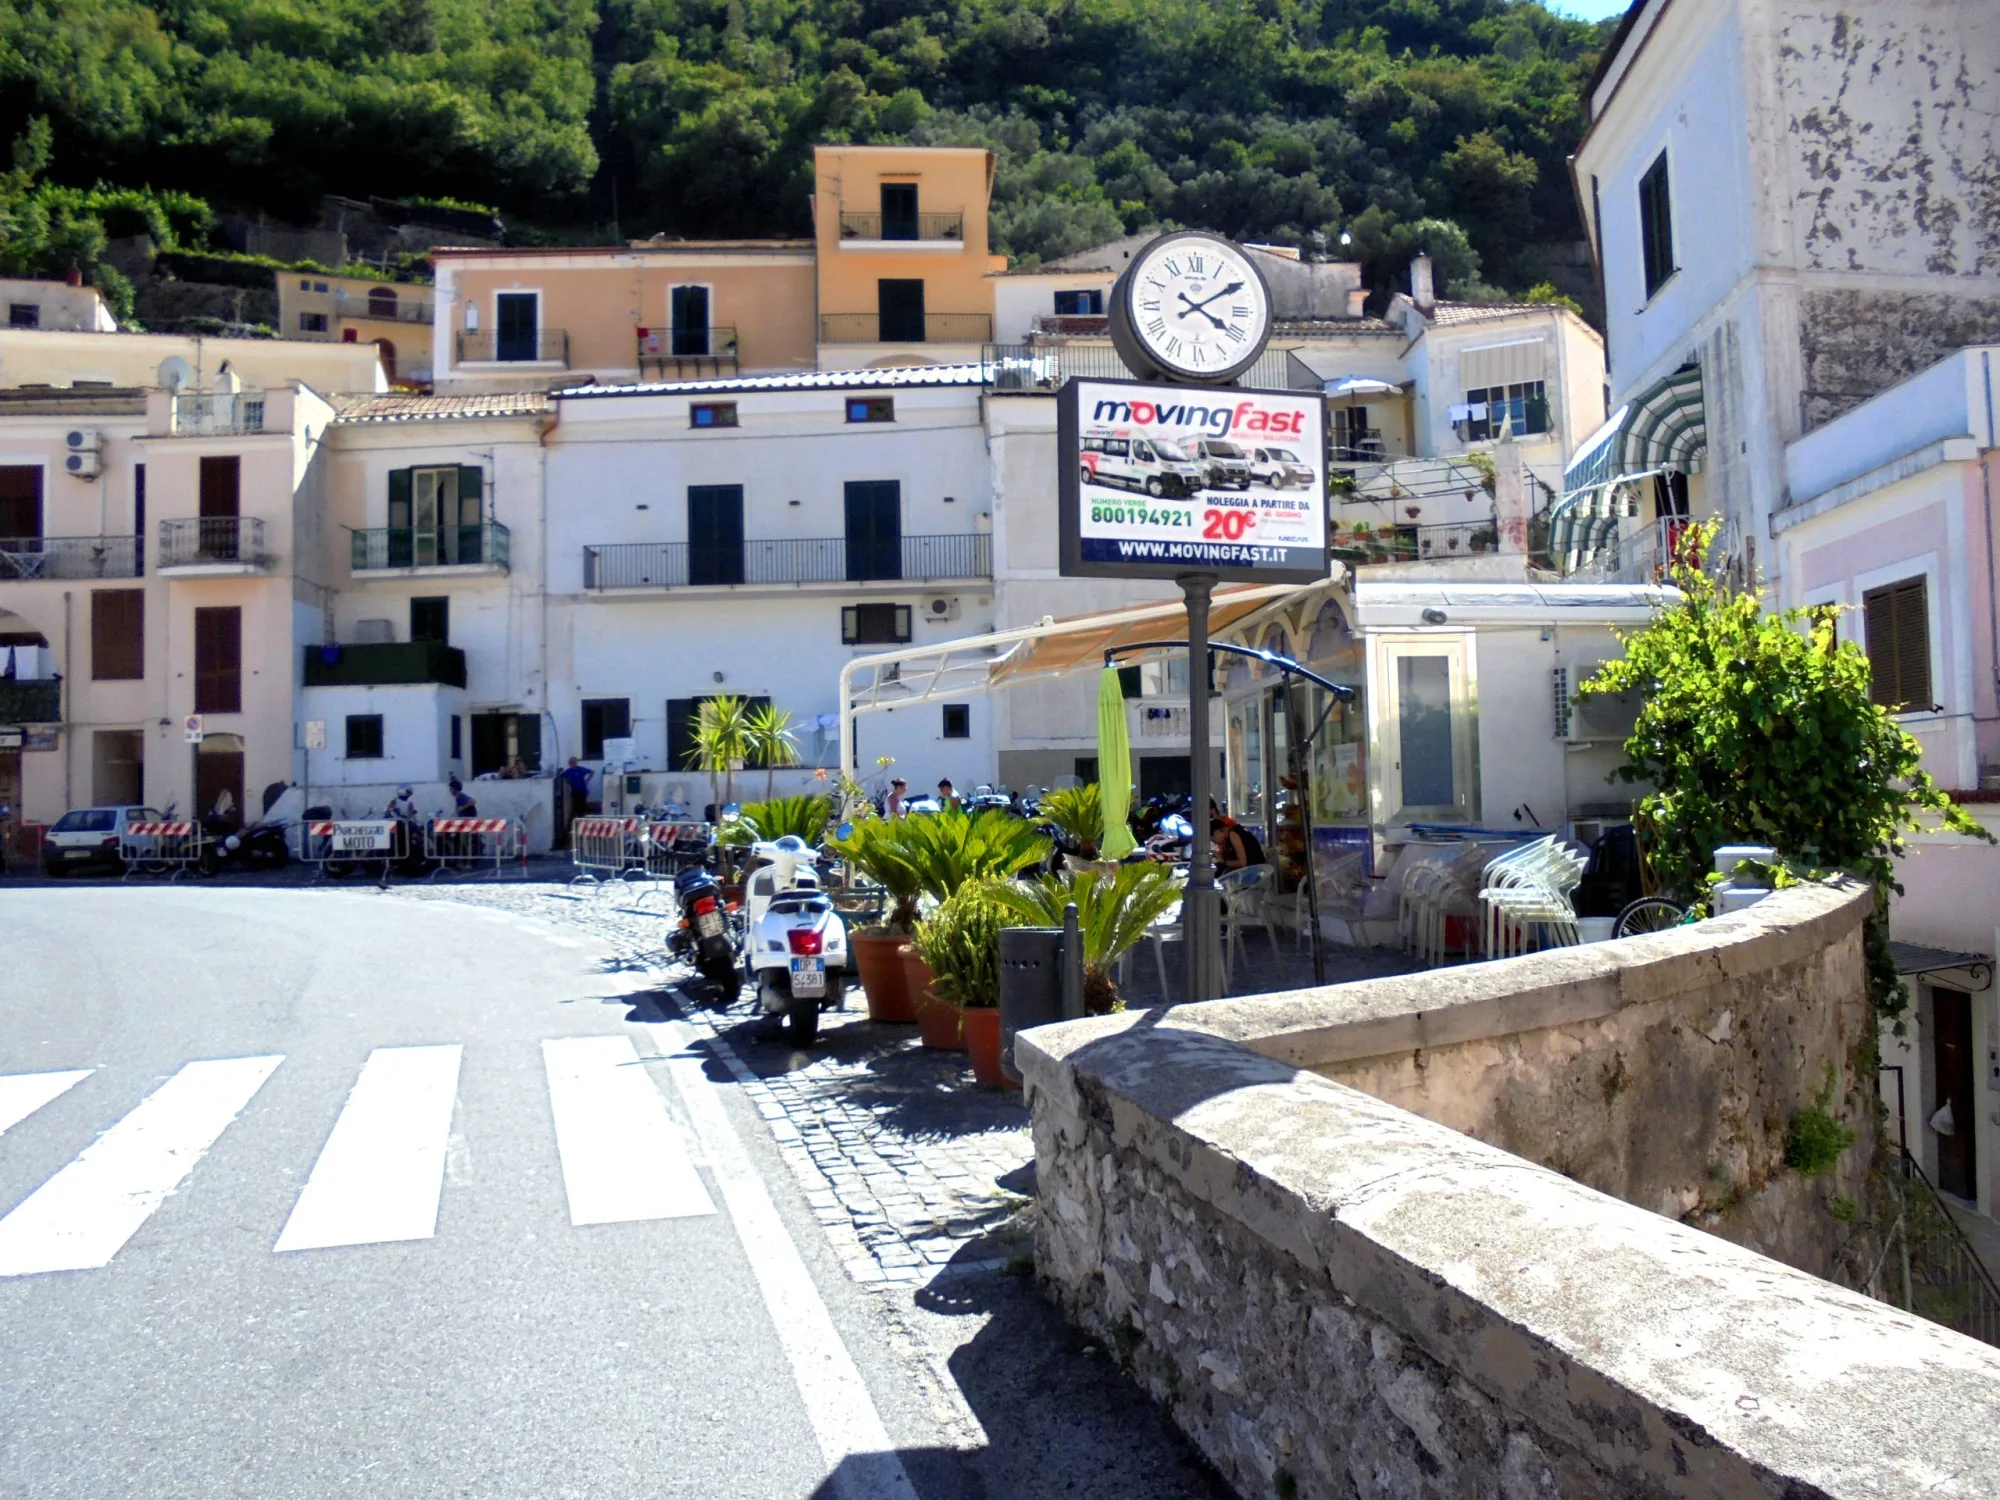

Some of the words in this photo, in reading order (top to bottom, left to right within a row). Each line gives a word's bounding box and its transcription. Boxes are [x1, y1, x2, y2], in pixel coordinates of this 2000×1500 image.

[1164, 260, 1181, 278] XI
[1188, 256, 1204, 274] XII
[1232, 306, 1248, 317] III
[1093, 400, 1306, 438] movingfast
[1091, 498, 1122, 506] NUMERO
[1124, 499, 1147, 507] VERDE
[1207, 496, 1249, 508] NOLEGGIA
[1252, 499, 1258, 508] A
[1261, 499, 1296, 510] PARTIRE
[1299, 501, 1310, 511] DA
[1091, 506, 1192, 527] 800194921
[1278, 535, 1308, 543] MECAR
[1118, 541, 1288, 562] WWW.MOVINGFAST.IT
[343, 836, 376, 849] MOTO
